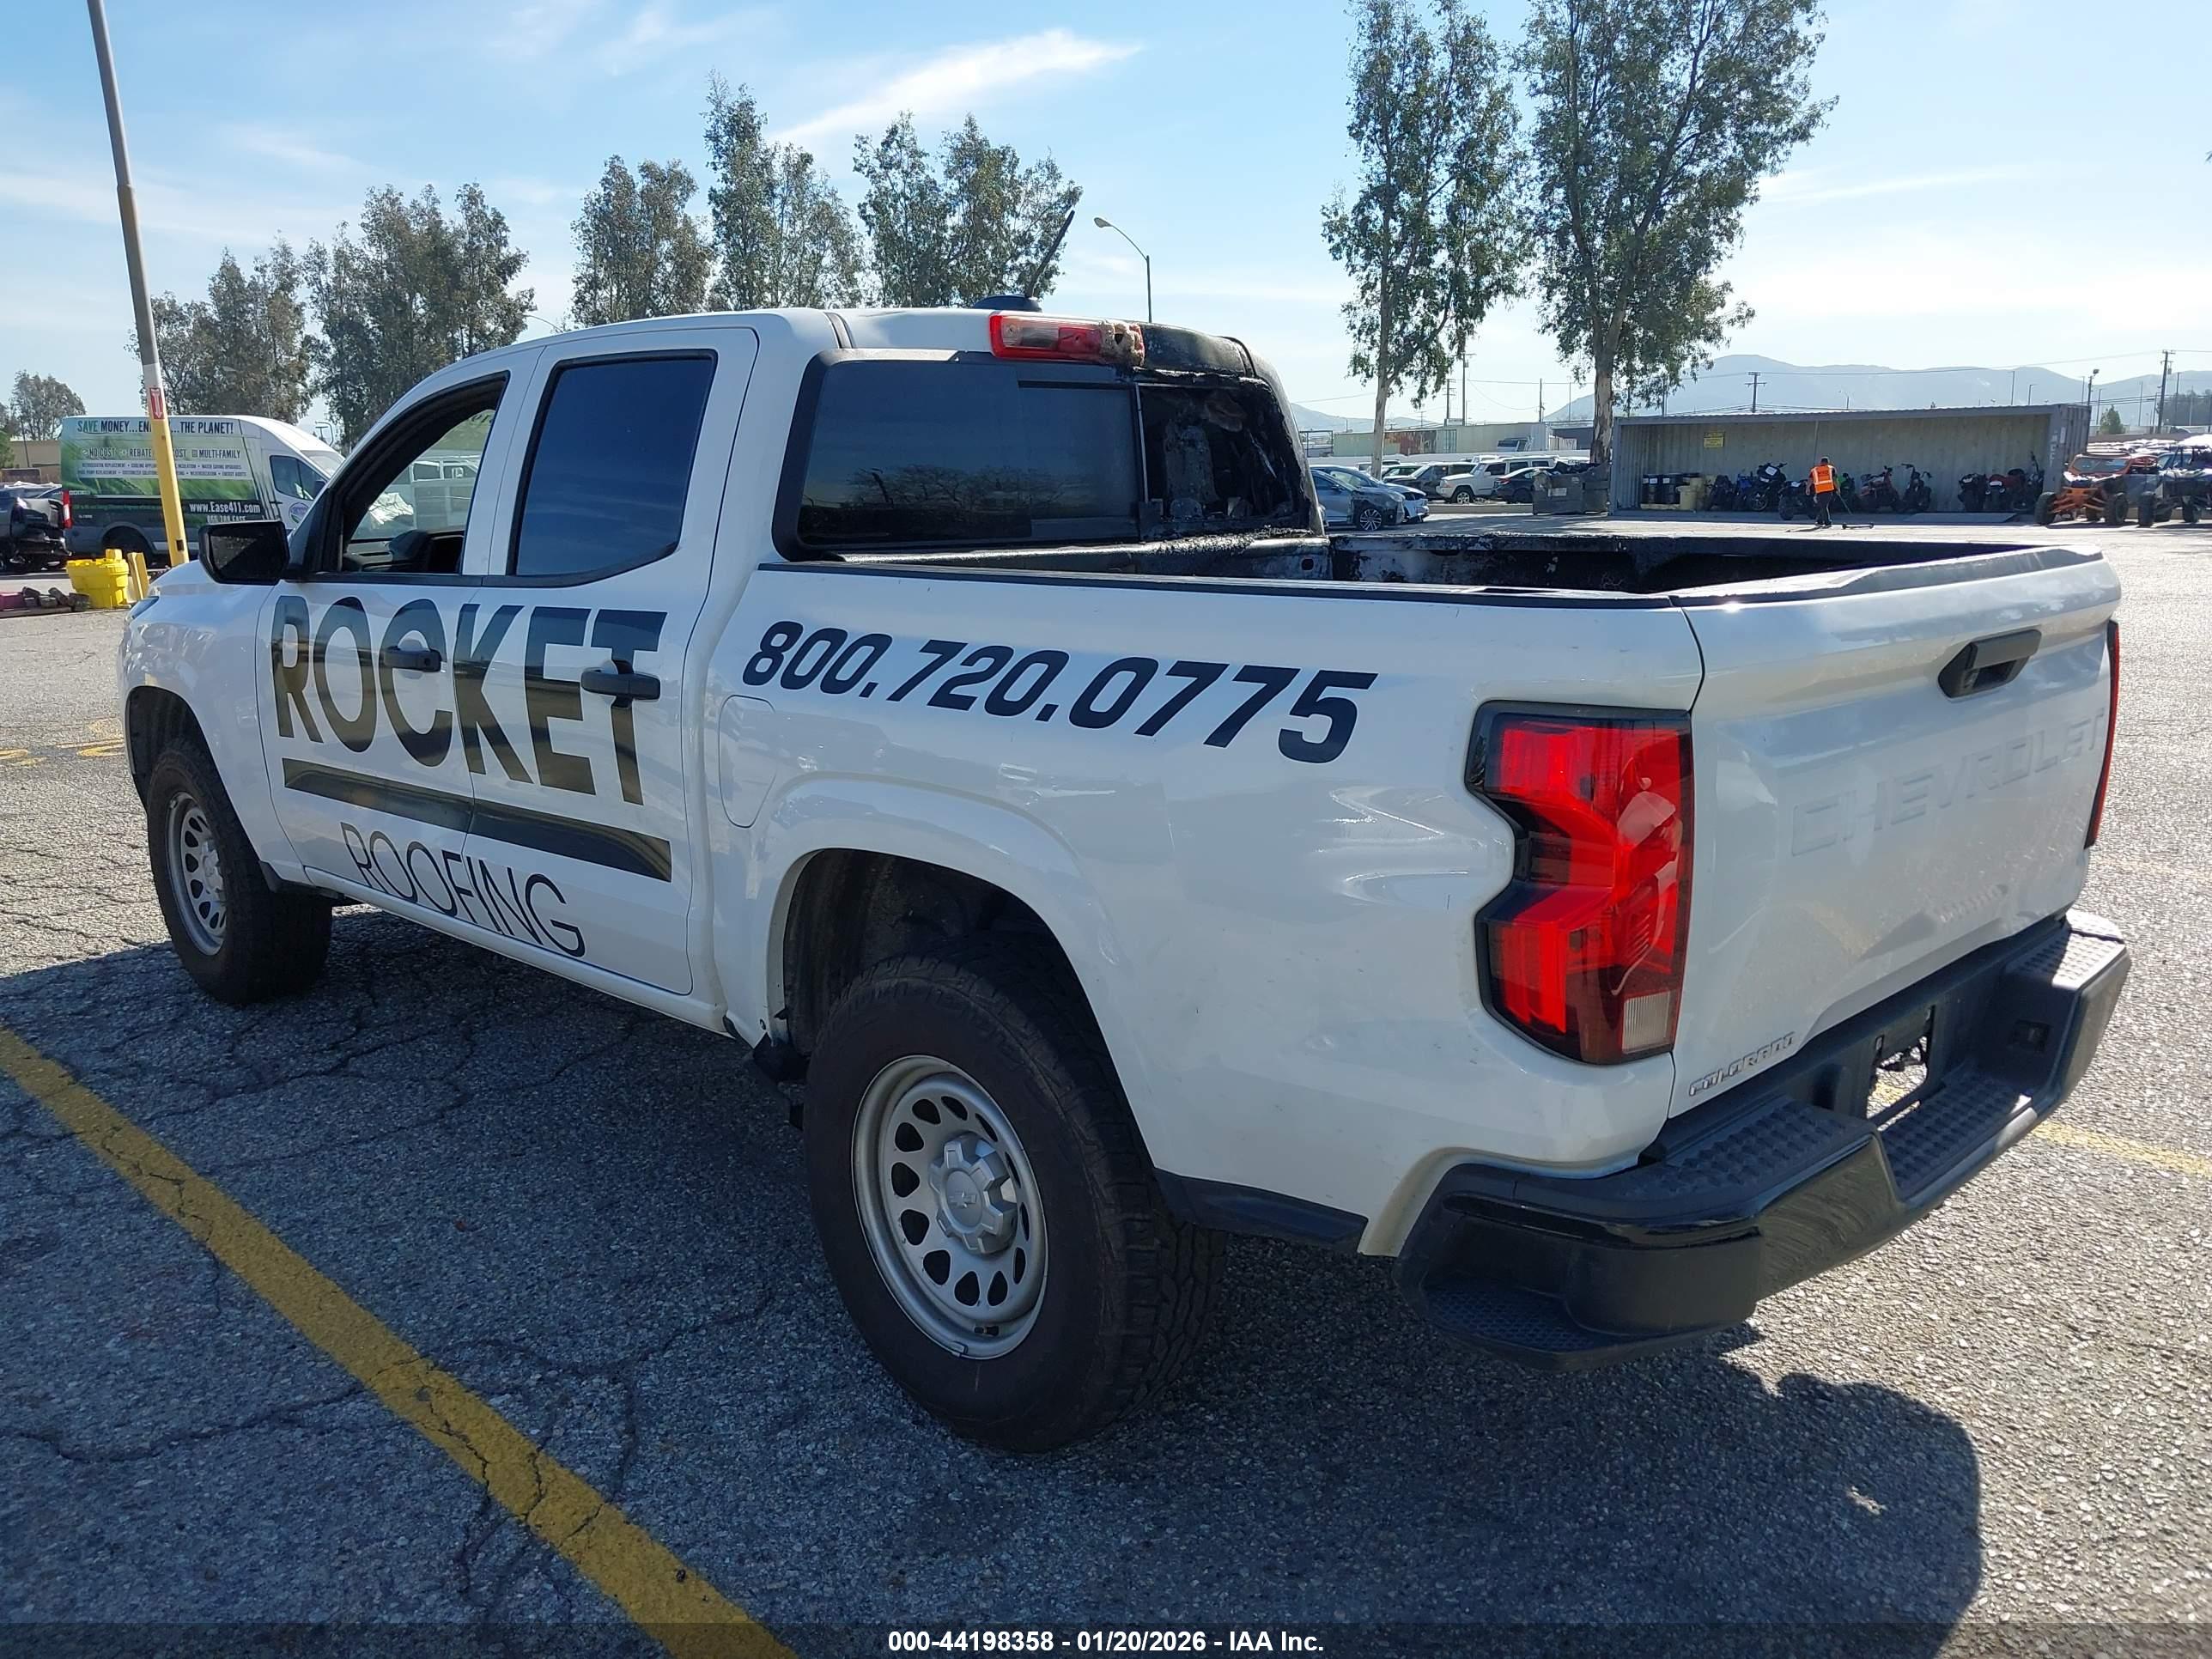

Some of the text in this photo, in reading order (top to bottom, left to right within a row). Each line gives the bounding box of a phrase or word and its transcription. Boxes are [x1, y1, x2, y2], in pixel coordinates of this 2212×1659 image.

[77, 420, 98, 433] SAVE
[198, 422, 234, 434] PLANET!
[198, 449, 241, 459] MULTI-FAMILY
[189, 501, 261, 514] www.Ease411.com
[271, 595, 667, 805] ROCKET
[742, 621, 1378, 763] 800.720.0775
[1791, 708, 2105, 857] CHEVROLET
[340, 822, 586, 957] ROOFING
[1689, 1031, 1796, 1097] COLORADO
